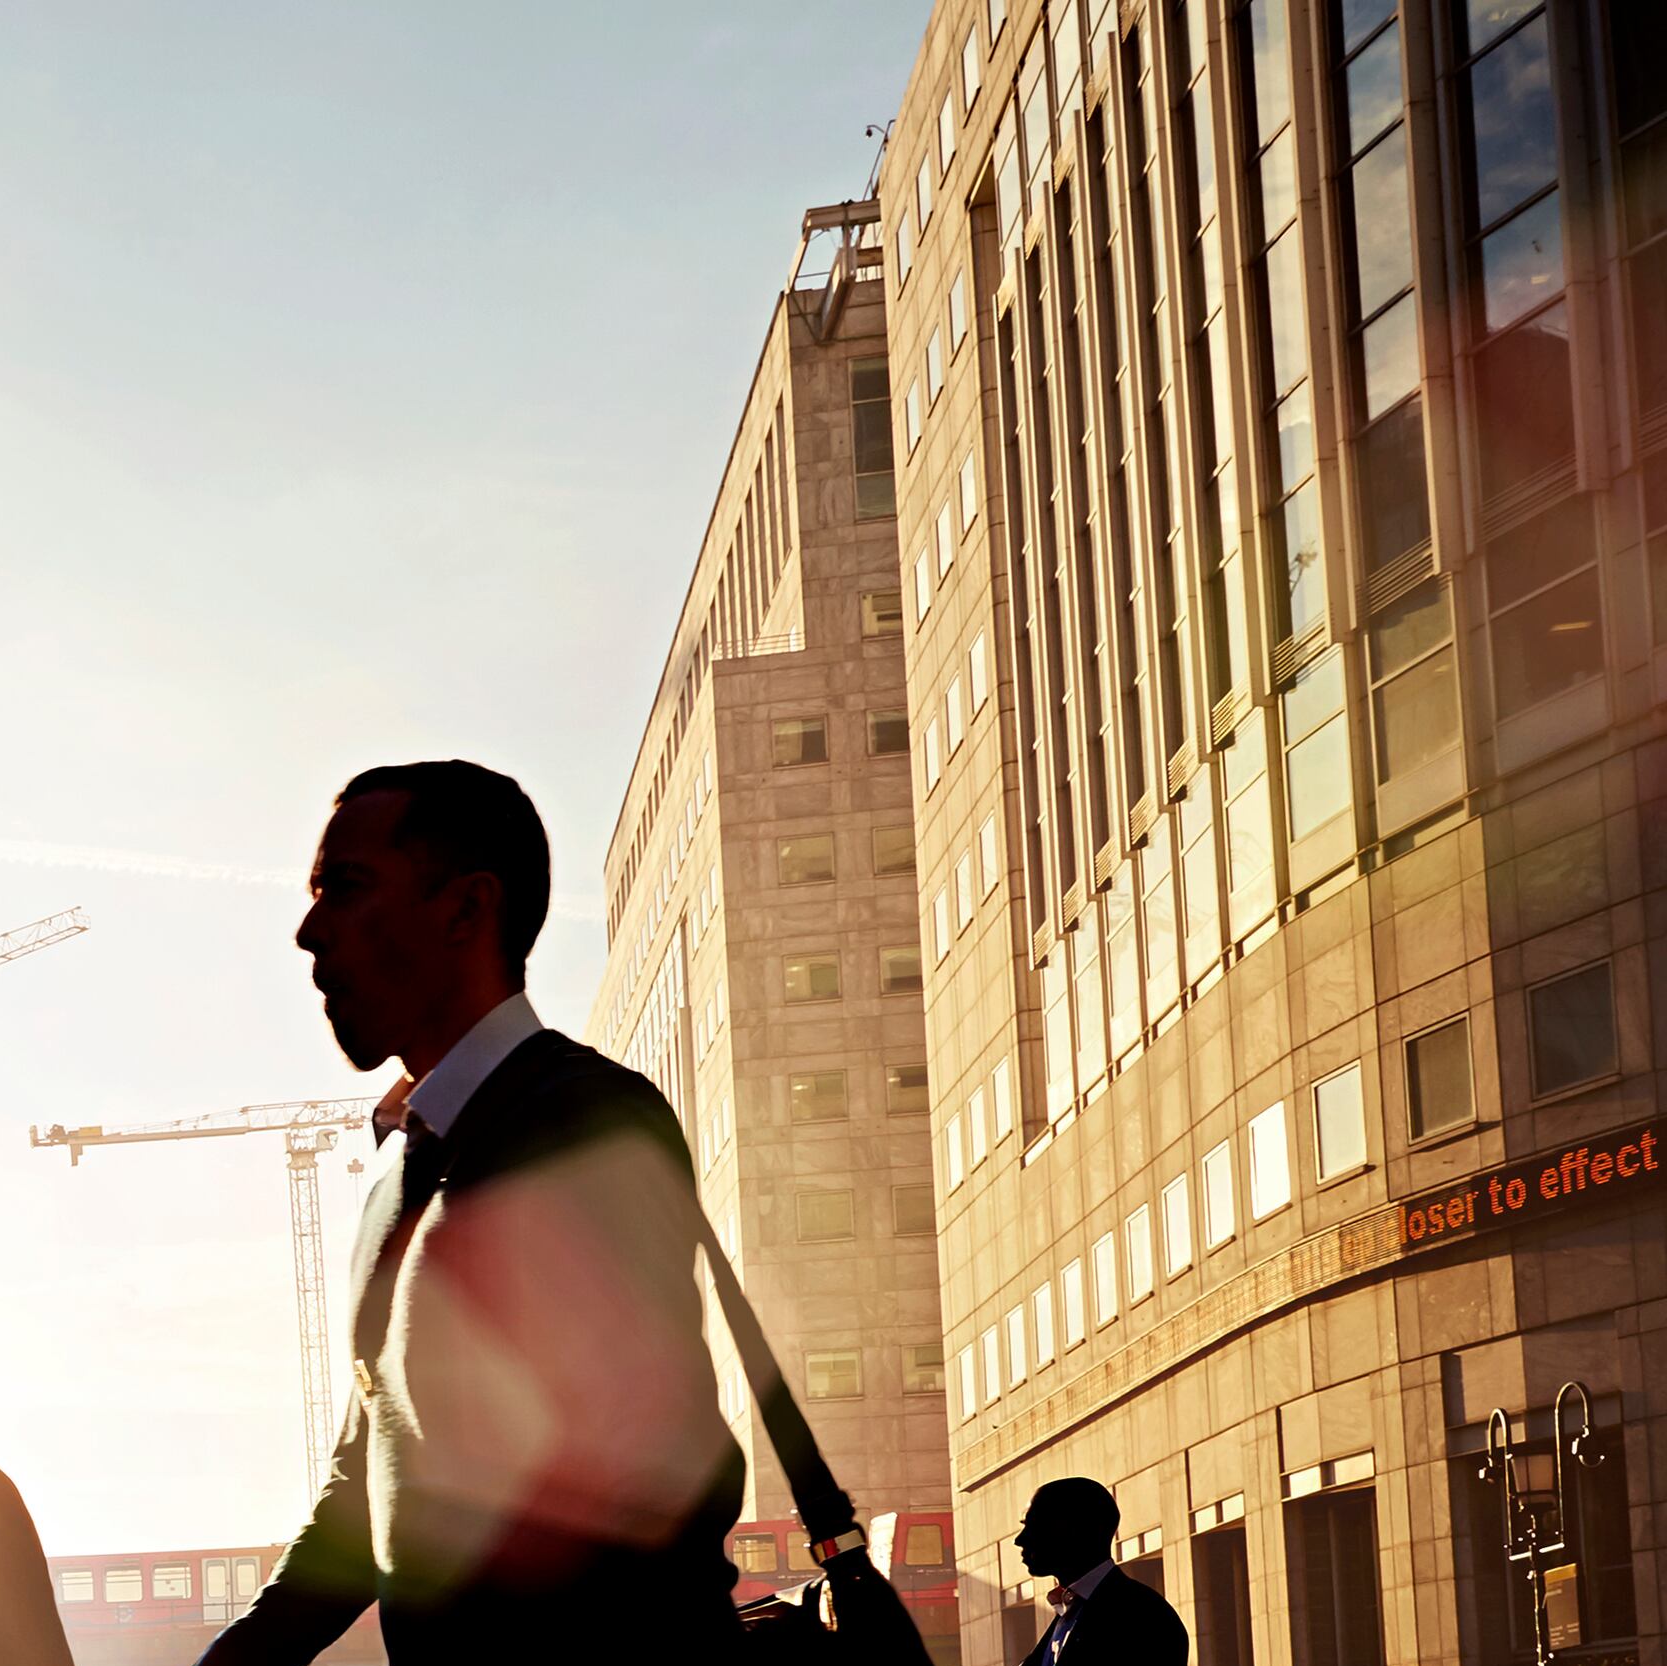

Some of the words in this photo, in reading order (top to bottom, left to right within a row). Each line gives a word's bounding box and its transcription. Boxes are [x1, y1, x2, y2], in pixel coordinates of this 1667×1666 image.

[1394, 1191, 1479, 1245] loser
[1488, 1175, 1527, 1215] to
[1539, 1129, 1658, 1200] effect
